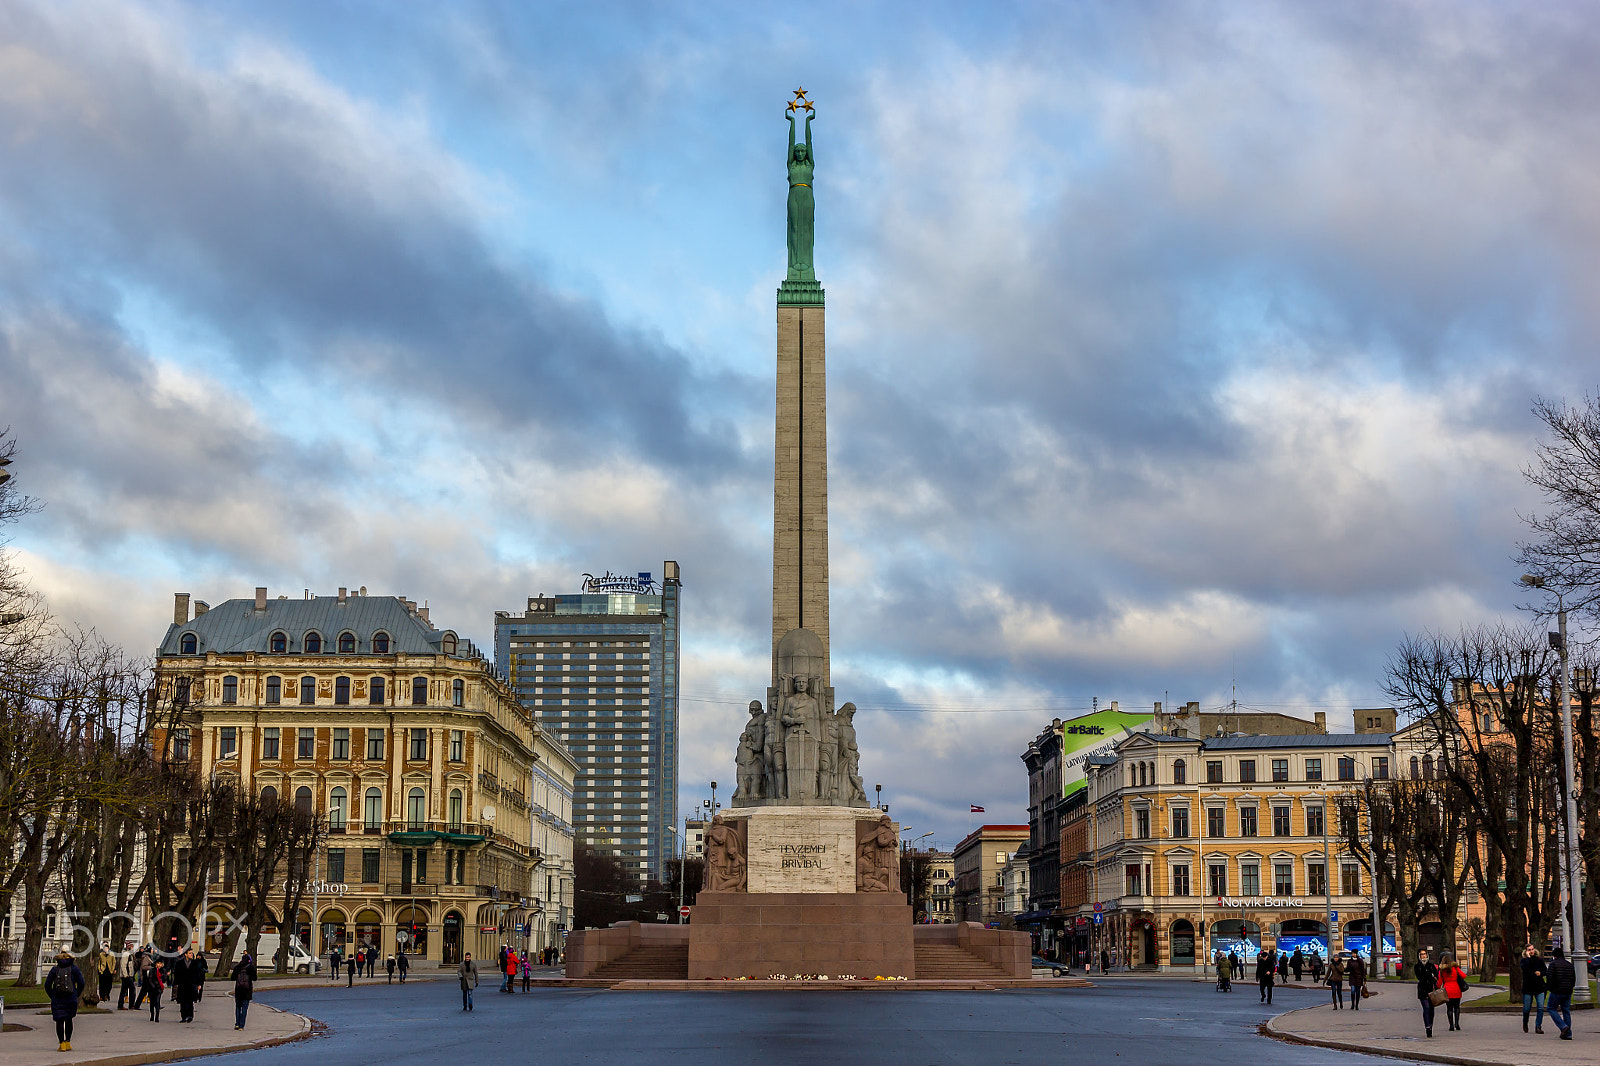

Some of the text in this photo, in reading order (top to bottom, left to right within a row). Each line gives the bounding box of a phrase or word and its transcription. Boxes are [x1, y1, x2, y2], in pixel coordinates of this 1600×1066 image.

[581, 570, 637, 591] Radisson
[1068, 725, 1104, 735] airBaltic
[282, 879, 348, 897] GitShop
[1222, 896, 1303, 907] Norvik Banka
